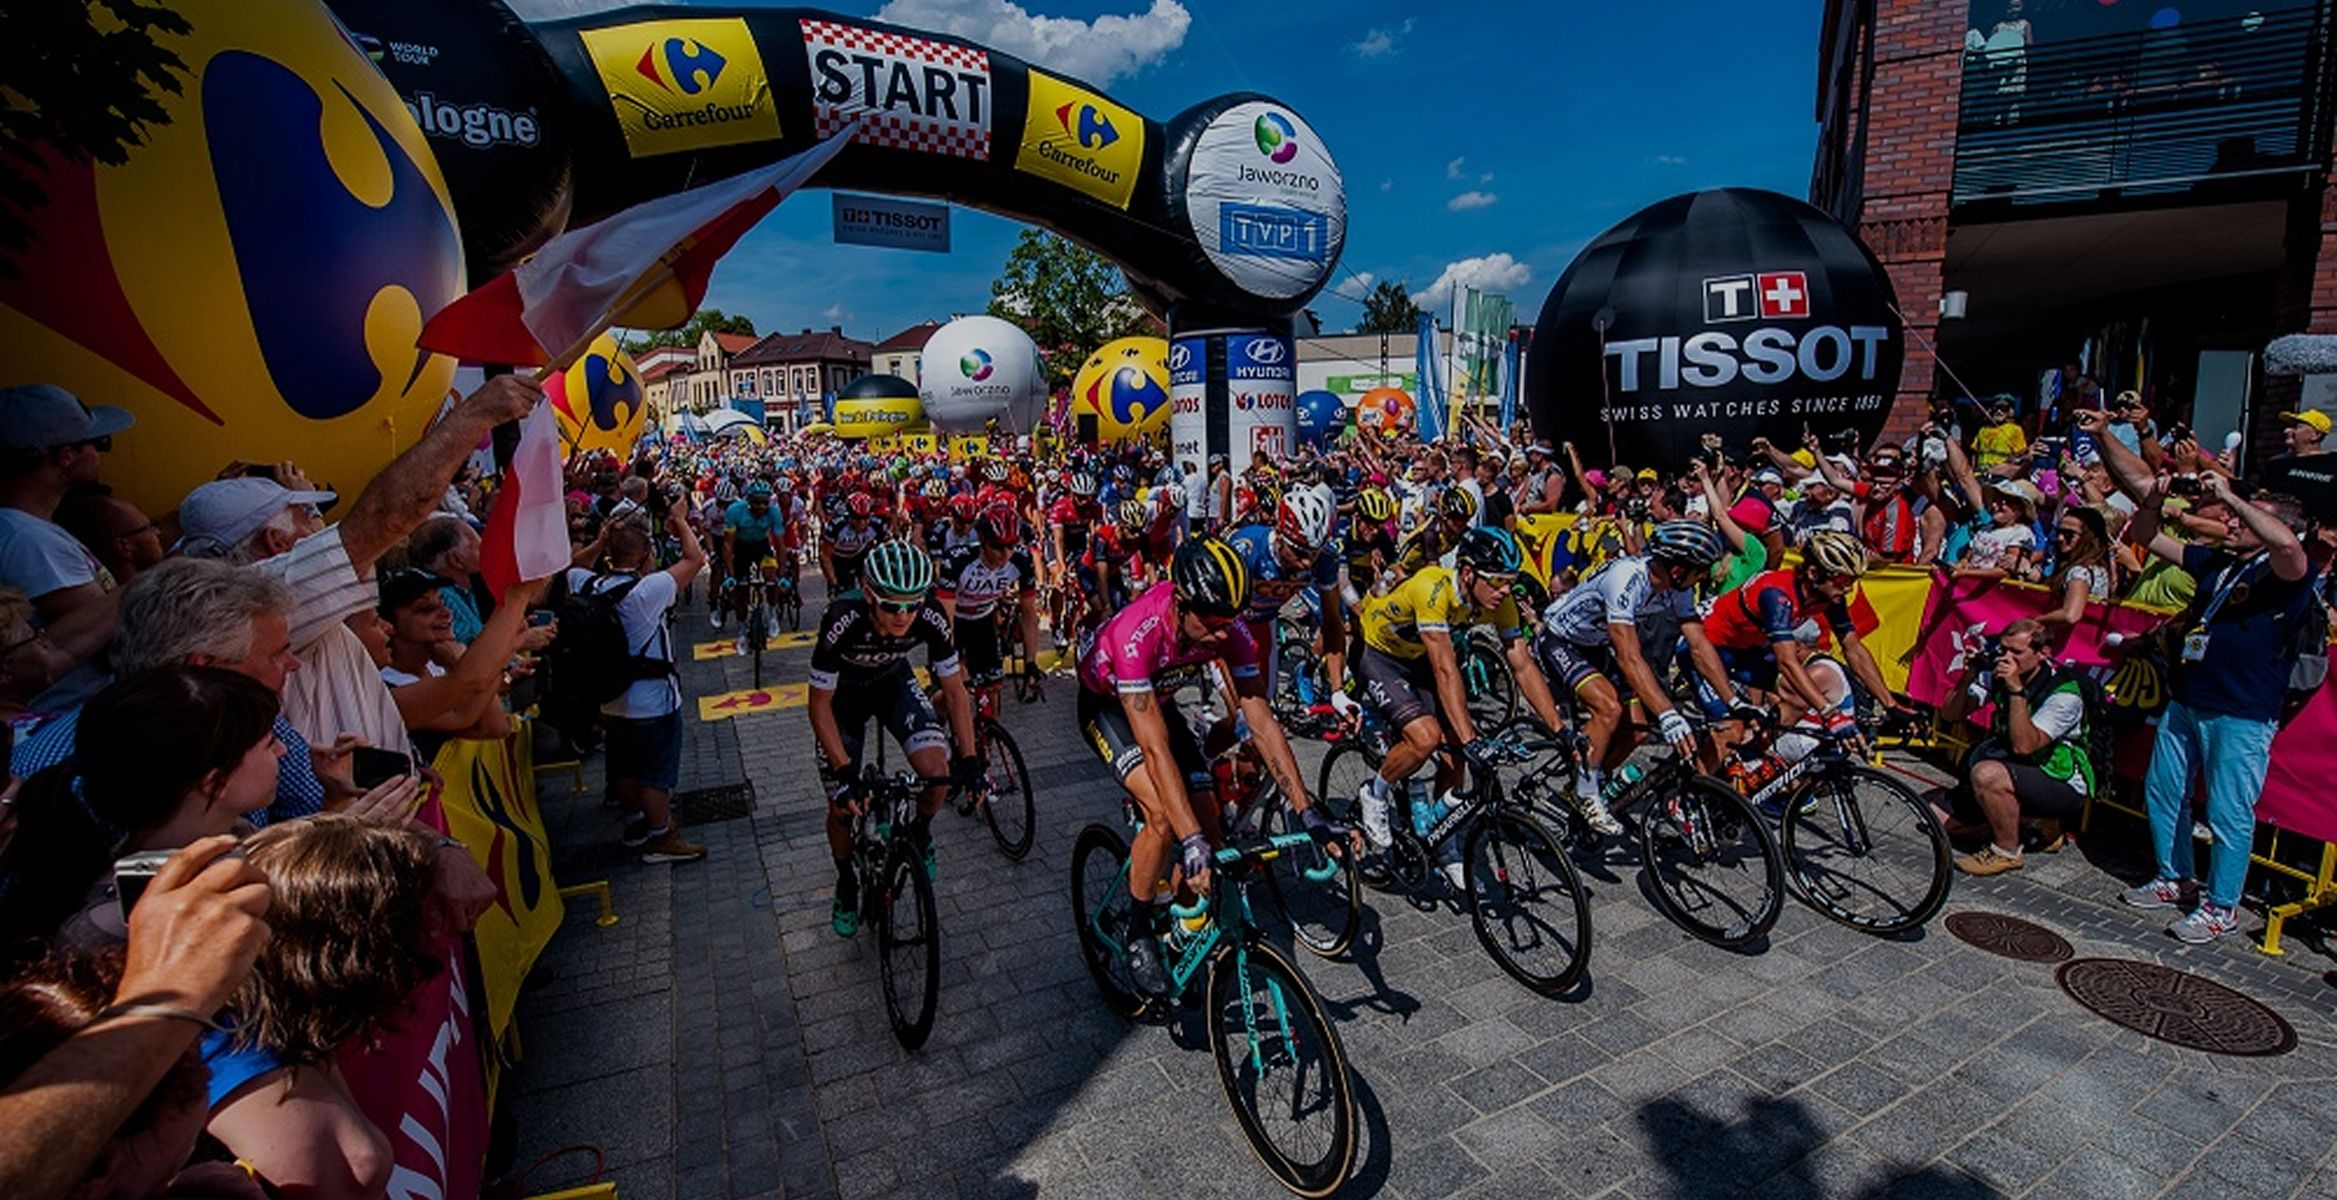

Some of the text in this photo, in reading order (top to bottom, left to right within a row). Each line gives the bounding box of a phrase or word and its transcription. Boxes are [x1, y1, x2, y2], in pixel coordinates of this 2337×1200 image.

[390, 41, 438, 58] WORLD
[394, 51, 431, 66] TOUR
[815, 50, 987, 123] START
[405, 95, 538, 146] ologne
[643, 102, 754, 131] Carrefour
[1039, 140, 1119, 184] Carrefour
[1236, 165, 1319, 191] Jaworzno
[871, 210, 941, 230] TISSOT
[1604, 325, 1890, 392] TISSOT
[1236, 366, 1291, 379] HYUNDA
[1172, 397, 1199, 414] OTOS
[1600, 405, 1663, 422] SWISS
[1671, 399, 1780, 420] WATCHES
[1791, 396, 1848, 415] SINCE
[965, 577, 1008, 592] UAE
[826, 609, 861, 644] BORA
